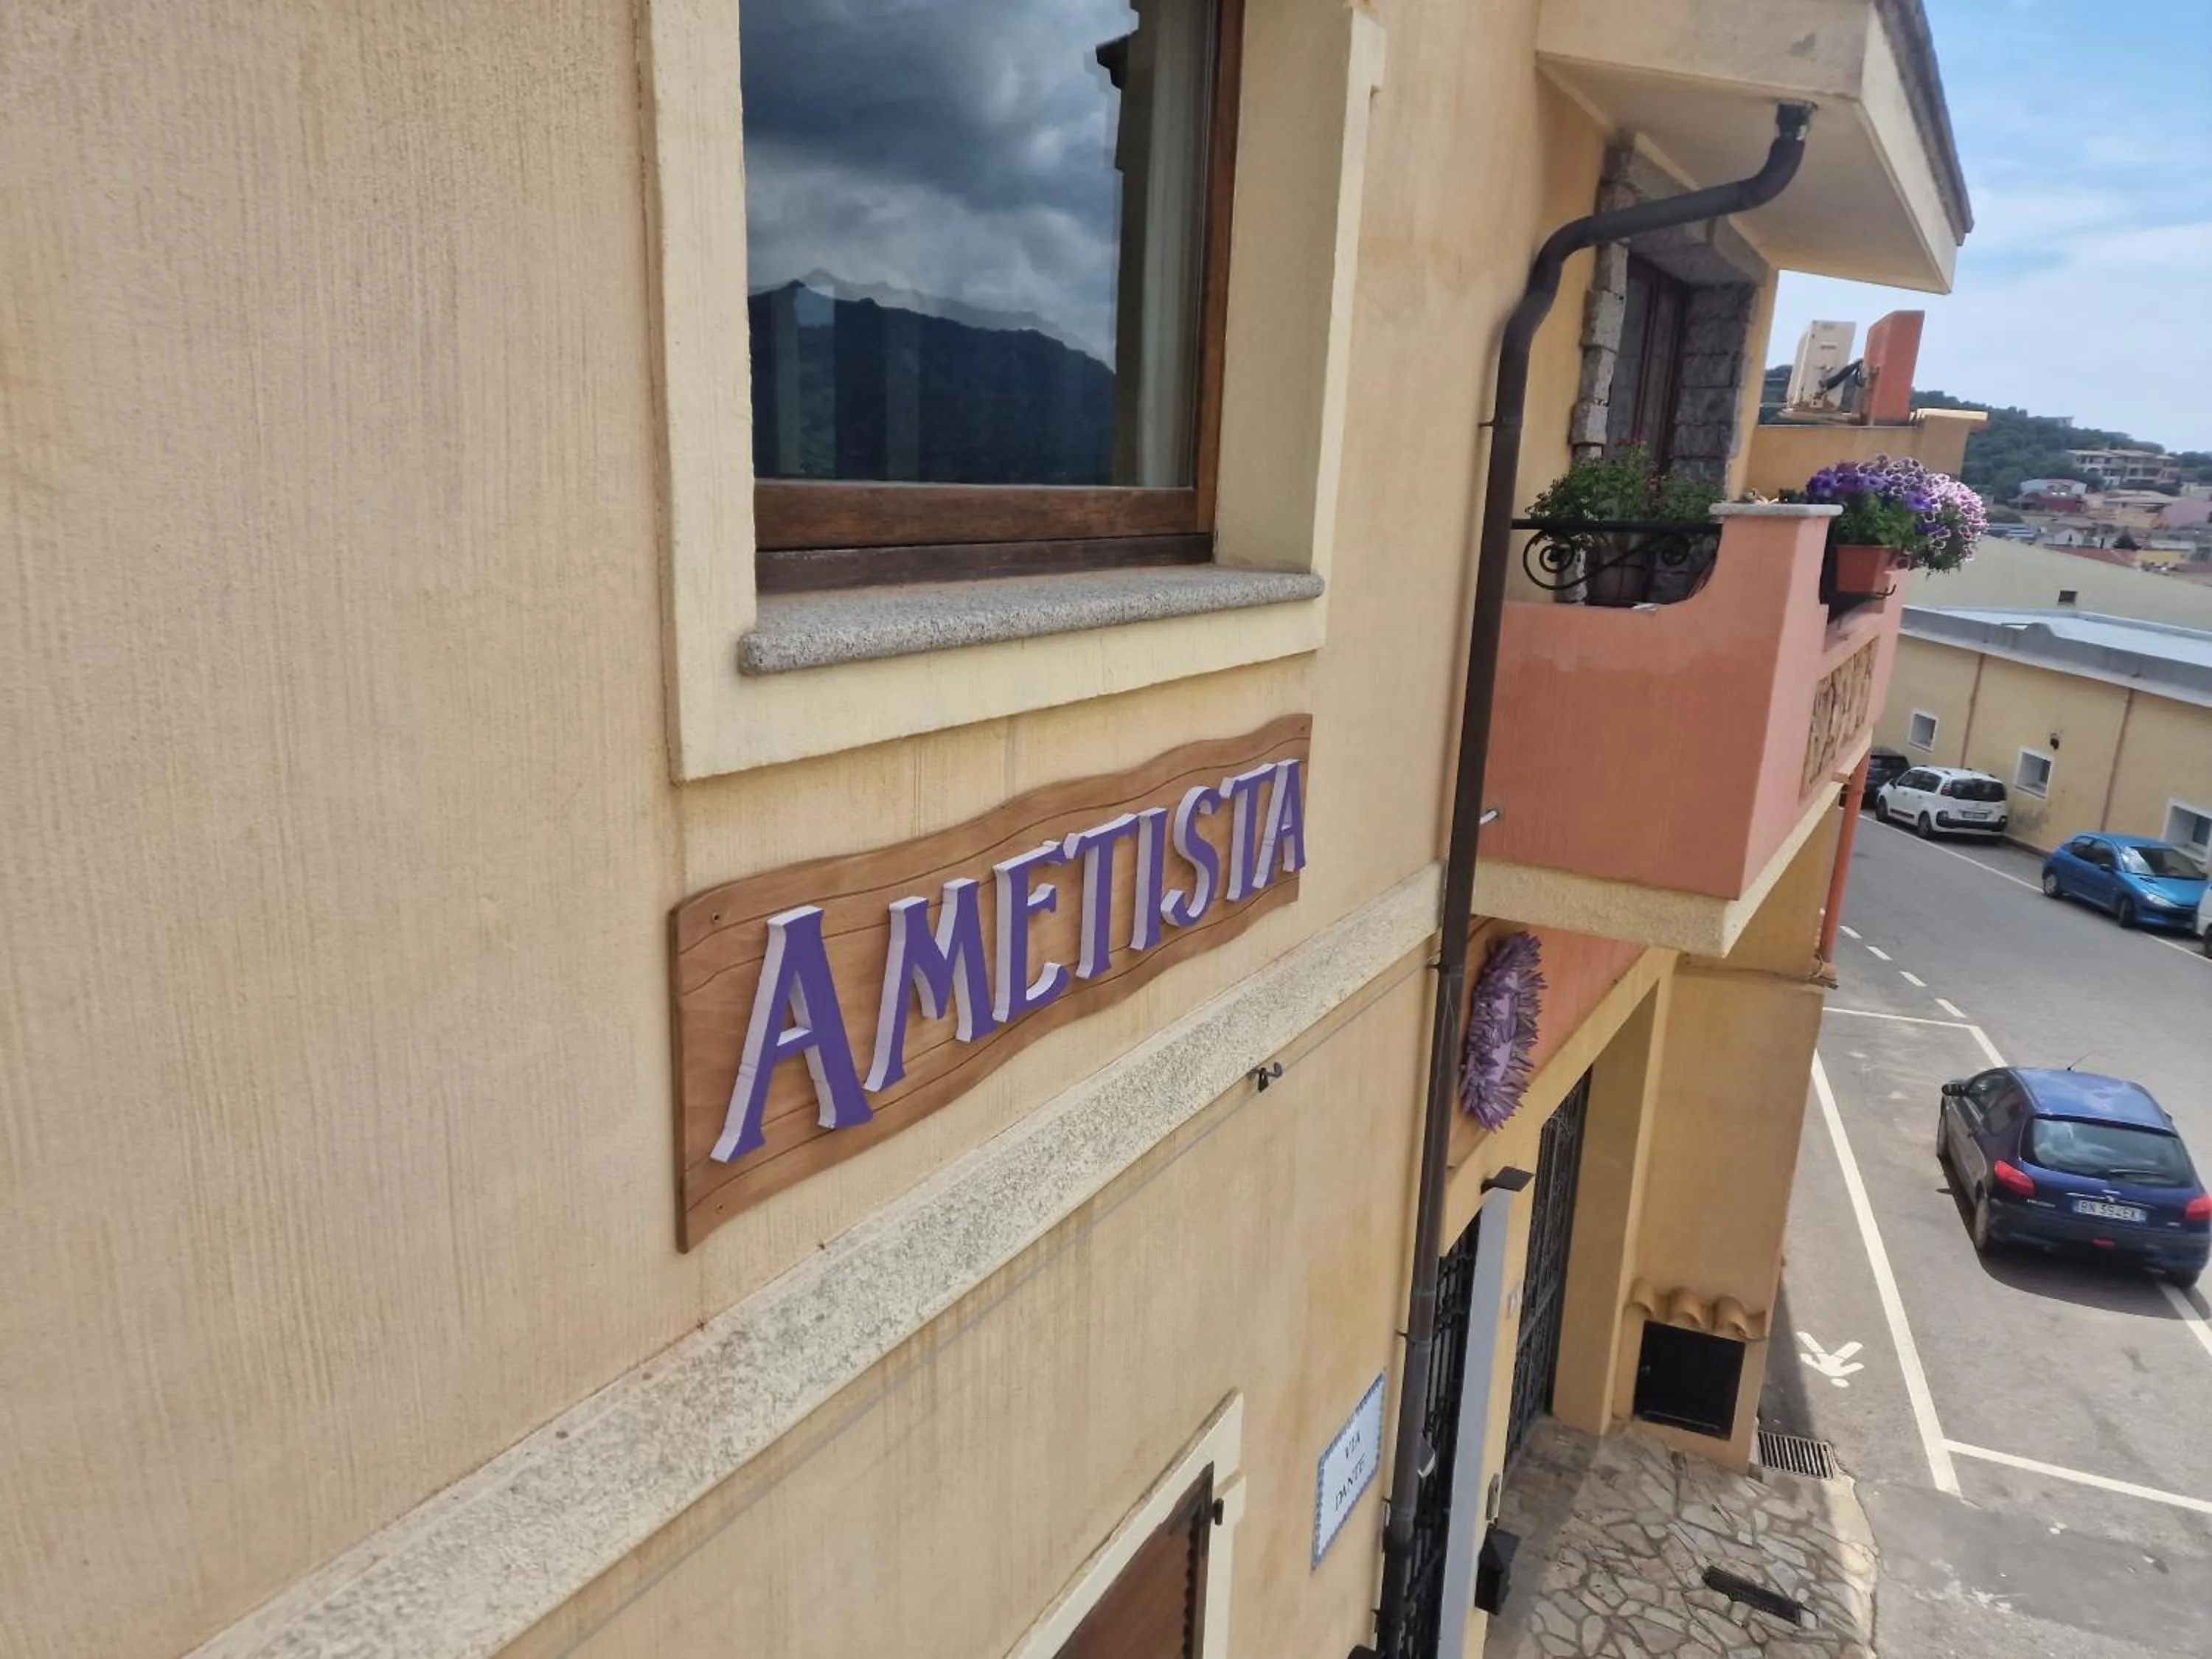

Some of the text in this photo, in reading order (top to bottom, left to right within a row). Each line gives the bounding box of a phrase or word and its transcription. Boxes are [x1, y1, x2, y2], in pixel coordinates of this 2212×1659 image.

[710, 759, 1307, 1163] AMETISTA
[1345, 1432, 1360, 1458] VIA
[1334, 1451, 1368, 1512] DANTE
